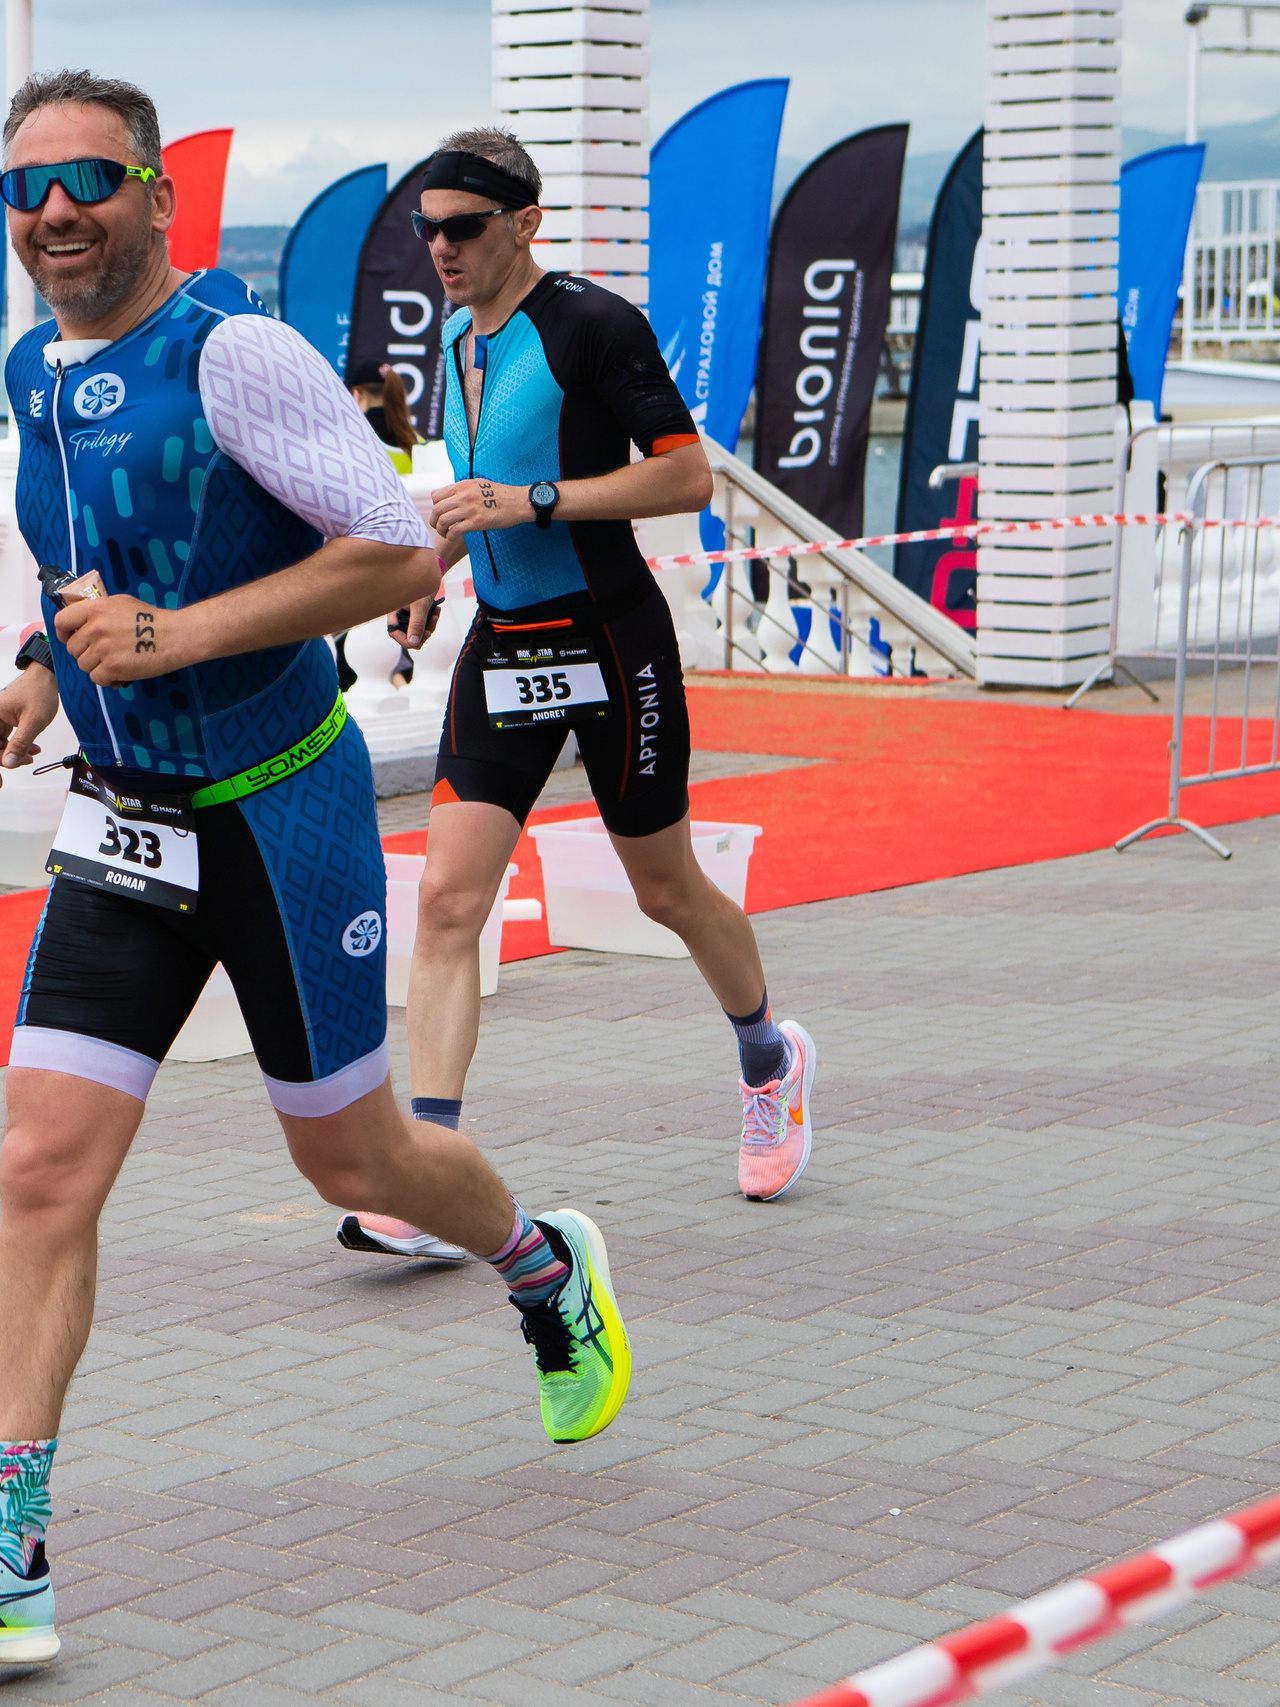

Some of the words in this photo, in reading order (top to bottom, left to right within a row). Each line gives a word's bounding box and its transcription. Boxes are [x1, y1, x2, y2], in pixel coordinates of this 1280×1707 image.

[696, 290, 718, 400] СТРАХОВОЙ
[707, 241, 723, 287] ДОМ
[778, 259, 857, 469] bioniq
[69, 428, 133, 461] Trilogy
[479, 482, 497, 509] 335
[515, 672, 571, 705] 335
[532, 709, 566, 721] ANDREY
[636, 663, 660, 775] APTONIA
[98, 815, 163, 869] 323
[105, 870, 147, 892] ROMAN
